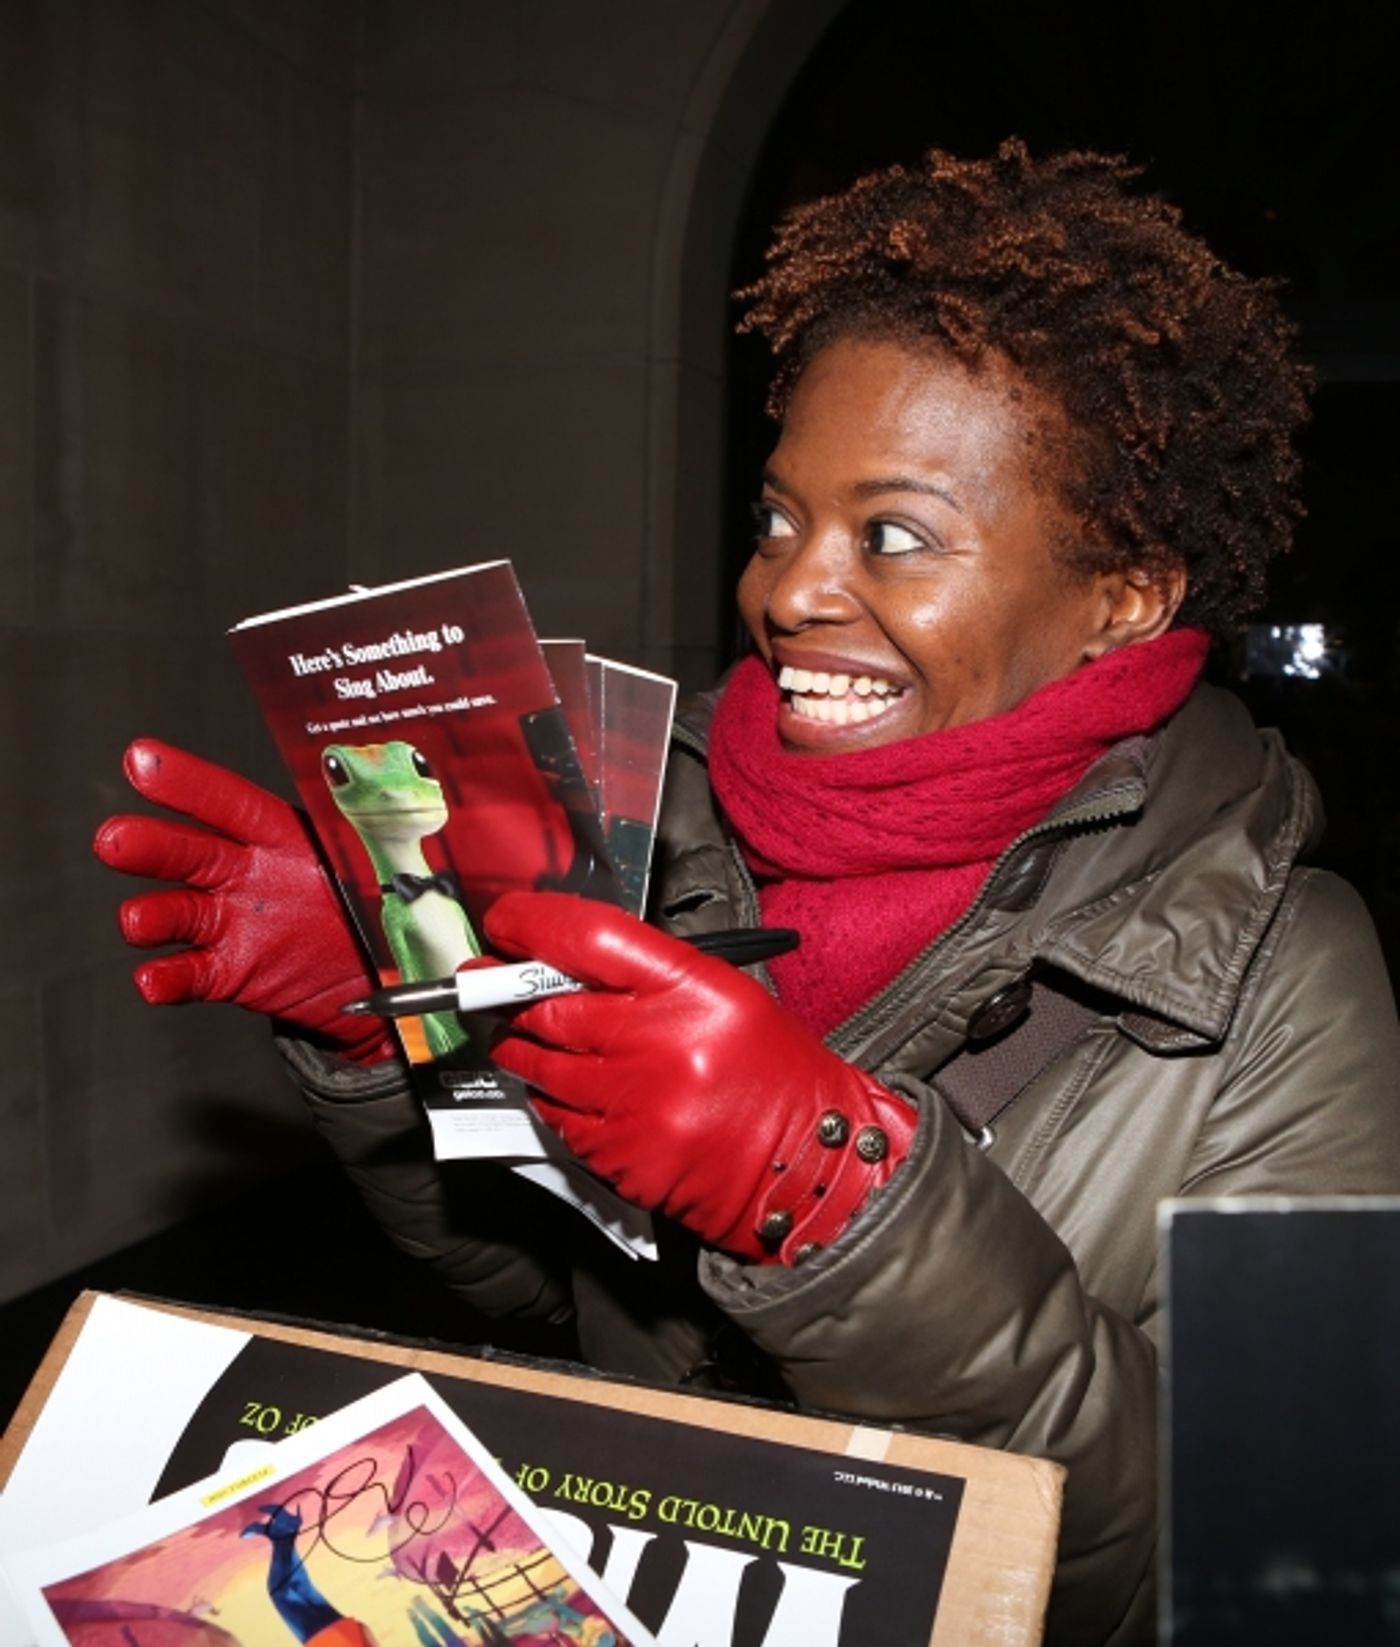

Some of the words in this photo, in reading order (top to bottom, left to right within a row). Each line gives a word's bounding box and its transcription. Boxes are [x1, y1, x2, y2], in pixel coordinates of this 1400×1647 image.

[289, 647, 344, 677] Here's
[342, 629, 443, 666] Something
[441, 623, 465, 645] to
[333, 677, 377, 699] Sing
[375, 664, 435, 693] About.
[515, 1464, 550, 1491] OF
[556, 1474, 652, 1521] STORY
[657, 1496, 791, 1553] UNTOLD
[803, 1526, 865, 1570] THE
